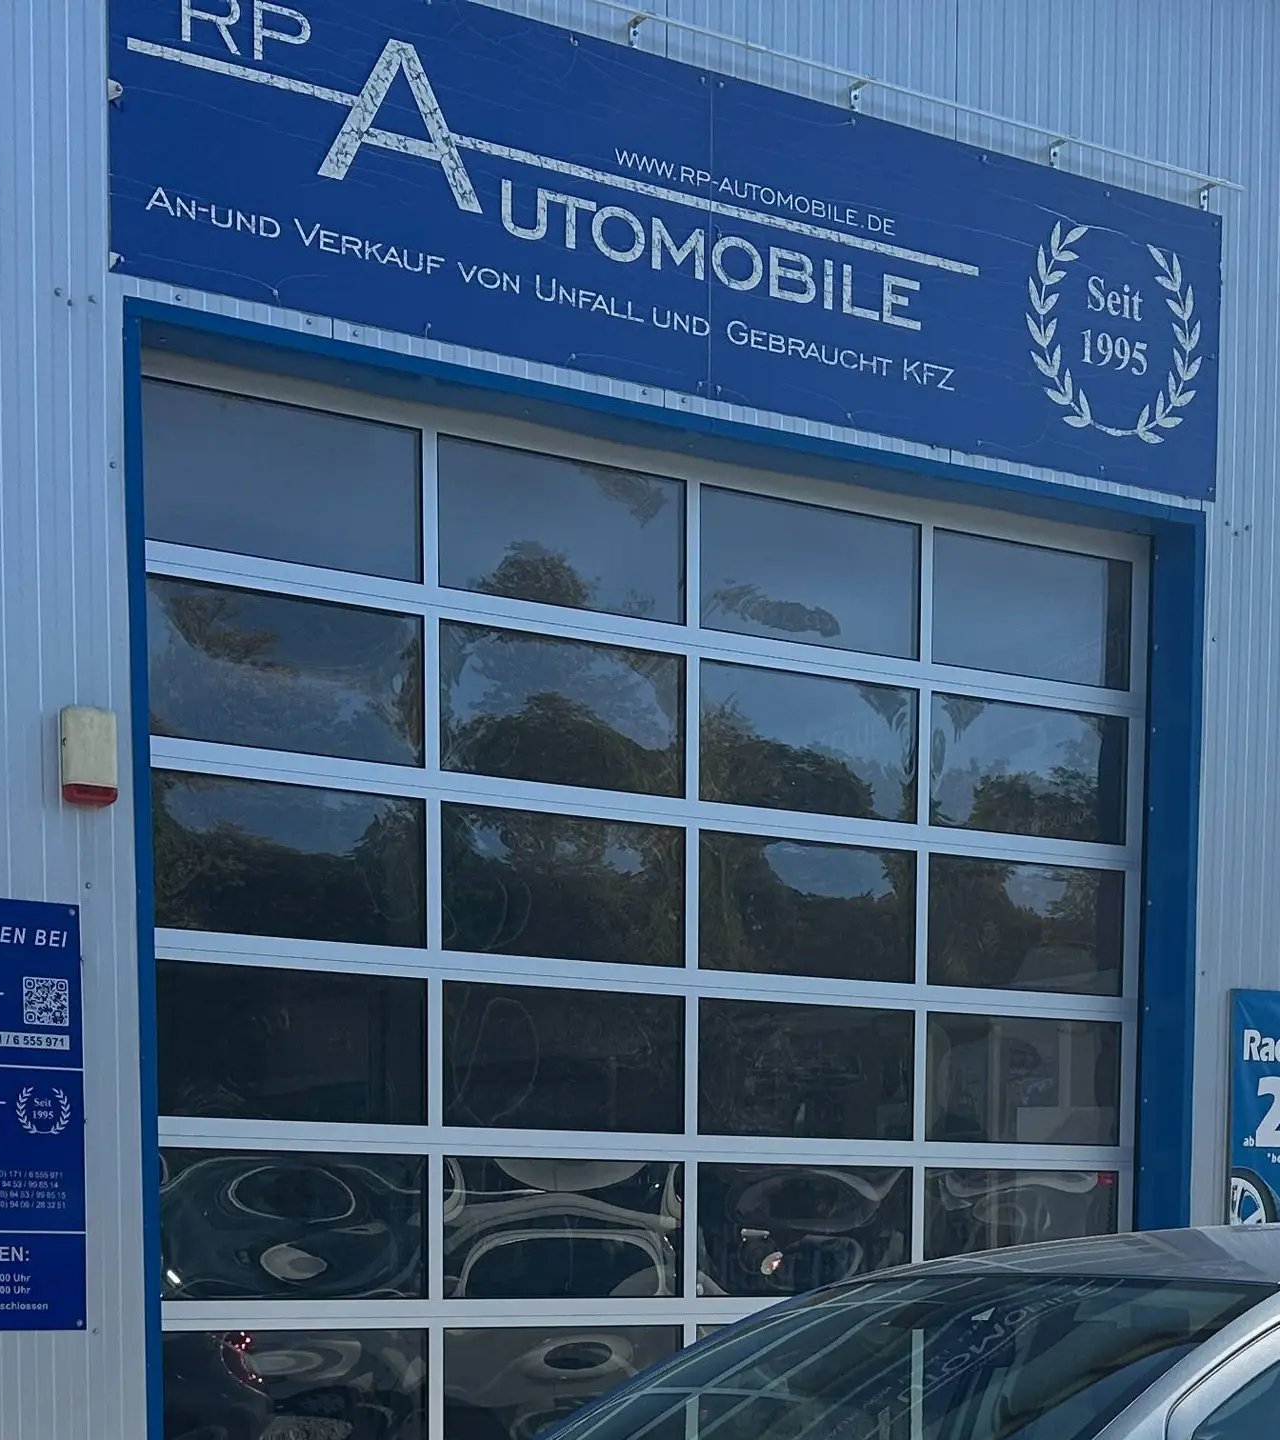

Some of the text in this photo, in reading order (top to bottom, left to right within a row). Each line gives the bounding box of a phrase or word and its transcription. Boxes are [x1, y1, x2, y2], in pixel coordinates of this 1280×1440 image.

[181, 0, 312, 60] RP
[317, 38, 922, 331] AUTOMOBILE
[614, 147, 895, 236] WWW.RP-AUTOMOBILE.DE
[145, 186, 955, 391] AN-UND VERKAUF VON UNFALL UND GEBRAUCHT KFZ
[1087, 276, 1143, 321] Seit
[1081, 329, 1148, 375] 1995
[34, 929, 67, 948] BEI
[6, 1035, 10, 1044] /
[13, 1035, 20, 1045] 6
[23, 1036, 43, 1046] 555
[45, 1037, 64, 1047] 971
[33, 1097, 52, 1108] Seit
[32, 1110, 54, 1120] 1995
[1243, 1137, 1255, 1147] ab
[13, 1273, 31, 1282] Uhr
[13, 1285, 31, 1294] Uhr
